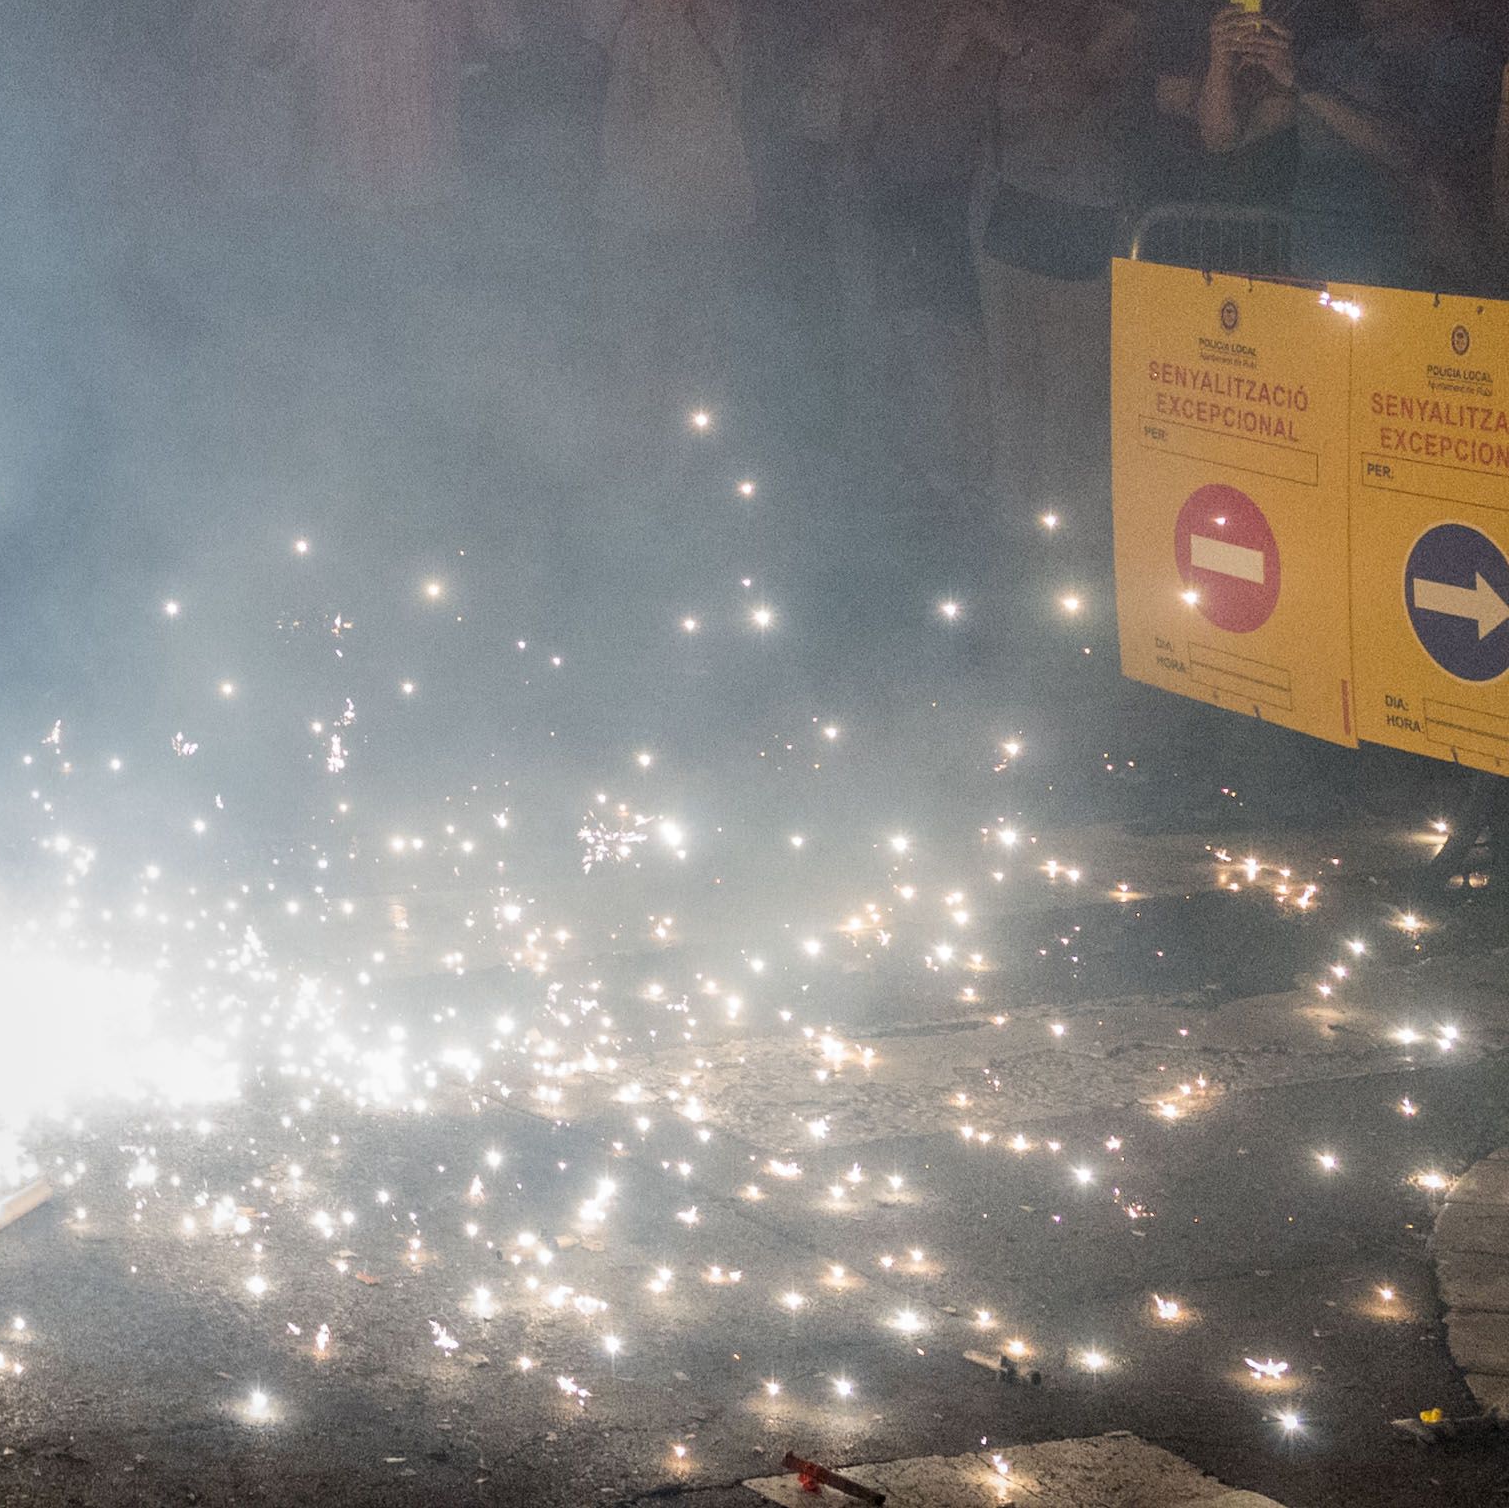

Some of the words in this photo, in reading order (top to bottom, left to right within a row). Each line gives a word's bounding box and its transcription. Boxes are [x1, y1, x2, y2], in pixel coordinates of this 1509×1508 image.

[1199, 337, 1230, 352] POLICIA
[1231, 342, 1257, 356] LOCAL
[1149, 360, 1309, 412] SENYALITZACIÓ
[1427, 364, 1461, 379] POLICIA
[1463, 369, 1493, 383] LOCAL
[1156, 393, 1299, 442] EXCEPCIONAL
